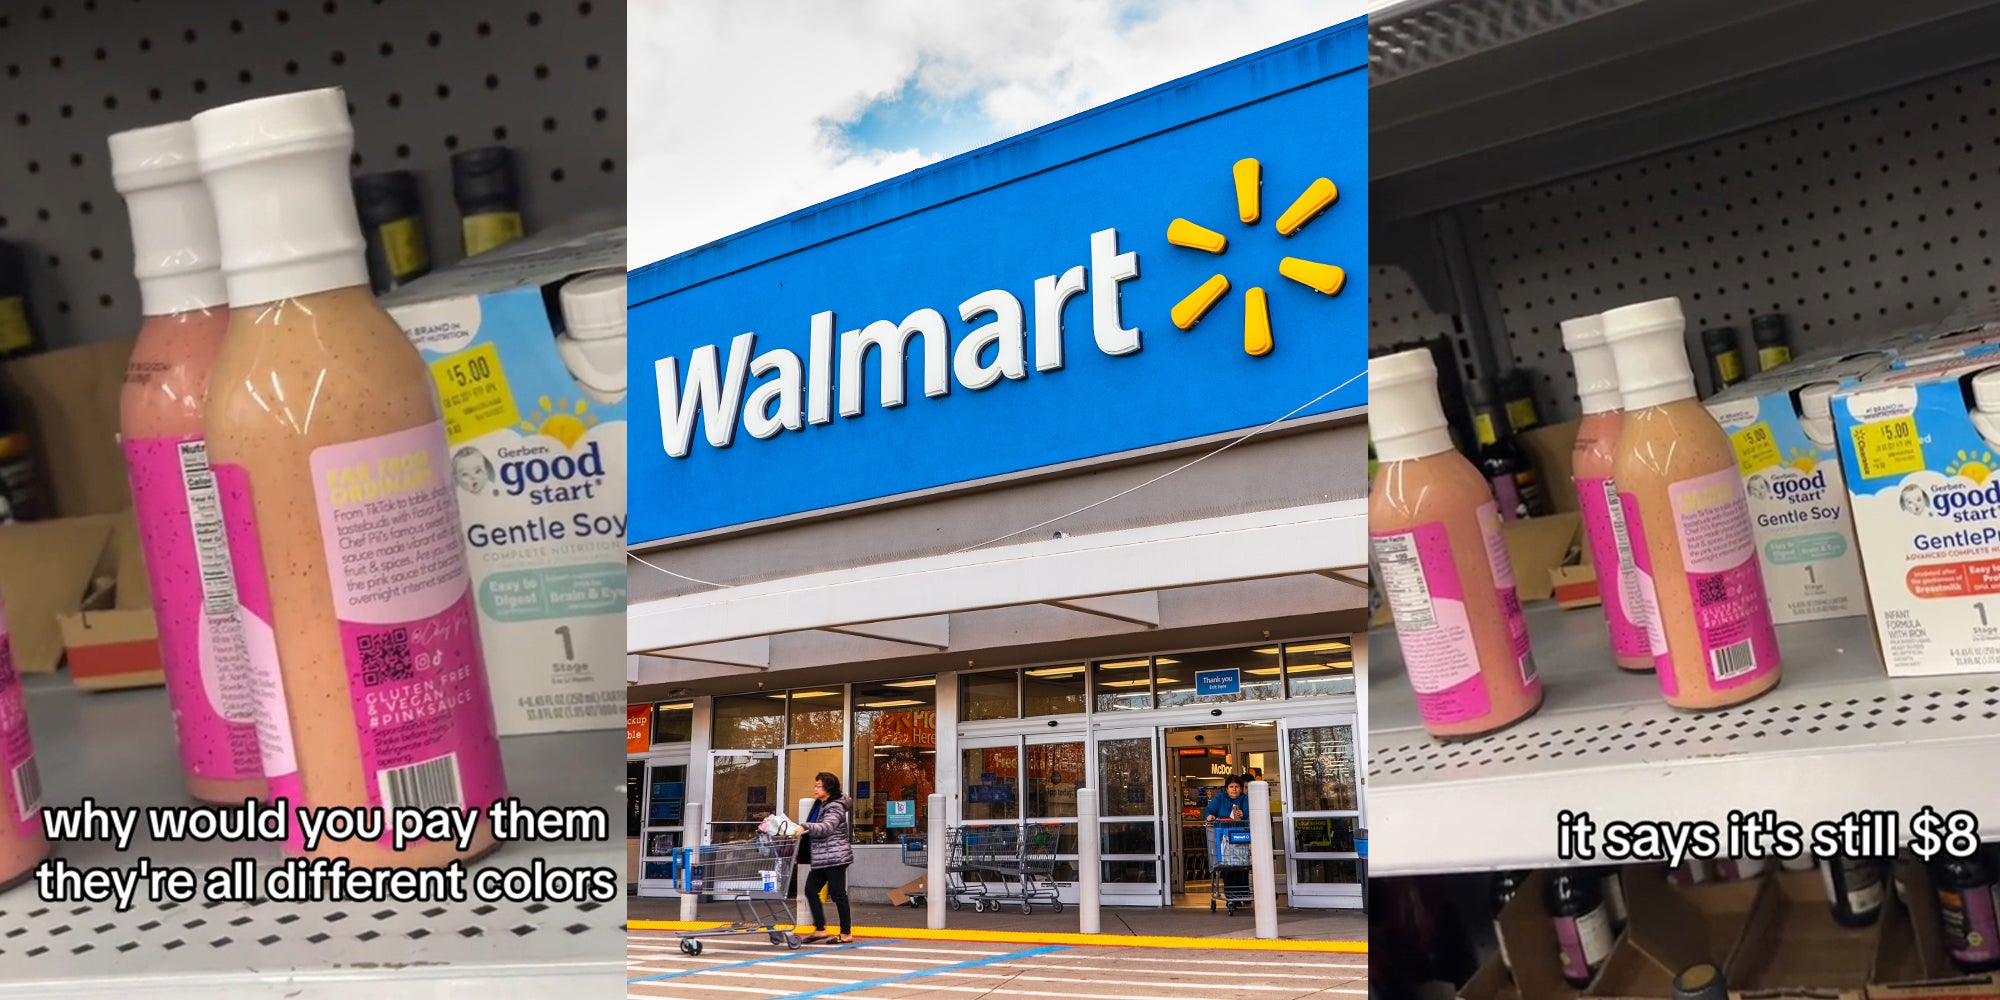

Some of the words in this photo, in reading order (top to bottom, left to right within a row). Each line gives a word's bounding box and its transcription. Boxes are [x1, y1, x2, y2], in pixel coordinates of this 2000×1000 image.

[654, 226, 1143, 458] Walmart
[447, 356, 490, 387] $5.00
[1880, 422, 1910, 440] $5.00
[500, 441, 605, 496] good
[1857, 440, 1870, 475] Clearance
[1773, 470, 1826, 499] good
[333, 509, 363, 522] From
[364, 500, 396, 516] TikTok
[396, 499, 407, 509] to
[1933, 480, 2000, 517] good
[337, 515, 390, 536] tastebuds
[391, 511, 411, 525] with
[1757, 509, 1808, 527] Gentle
[1811, 506, 1840, 520] Soy
[339, 535, 366, 549] Chef
[390, 523, 425, 540] famous
[467, 516, 566, 548] Gentle
[572, 512, 627, 538] Soy
[1914, 527, 2000, 551] GentleP
[342, 550, 374, 565] sauce
[376, 541, 405, 557] made
[1905, 551, 1947, 561] ADVANCED
[1948, 548, 1989, 558] COMPLETE
[344, 564, 367, 578] fruit
[369, 560, 379, 574] &
[347, 579, 365, 592] the
[367, 573, 390, 592] pink
[390, 568, 419, 583] sauce
[1804, 565, 1816, 583] 1
[1969, 565, 1991, 575] Easy
[348, 586, 400, 606] overnight
[402, 576, 436, 595] internet
[489, 580, 520, 593] Easy
[1915, 582, 1962, 594] Breastmilk
[1884, 609, 1910, 619] INFANT
[1886, 619, 1922, 629] FORMULA
[1973, 602, 1988, 626] 1
[1889, 629, 1908, 638] WITH
[1909, 628, 1927, 638] IRON
[1972, 626, 1998, 635] Stage
[555, 625, 574, 661] 1
[552, 663, 589, 675] Stage
[1202, 676, 1221, 684] Thank
[1222, 676, 1233, 684] you
[365, 680, 434, 705] GLUTEN
[440, 664, 472, 687] FREE
[367, 704, 378, 717] &
[386, 689, 444, 712] VEGAN
[369, 688, 473, 728] #PINKSAUCE
